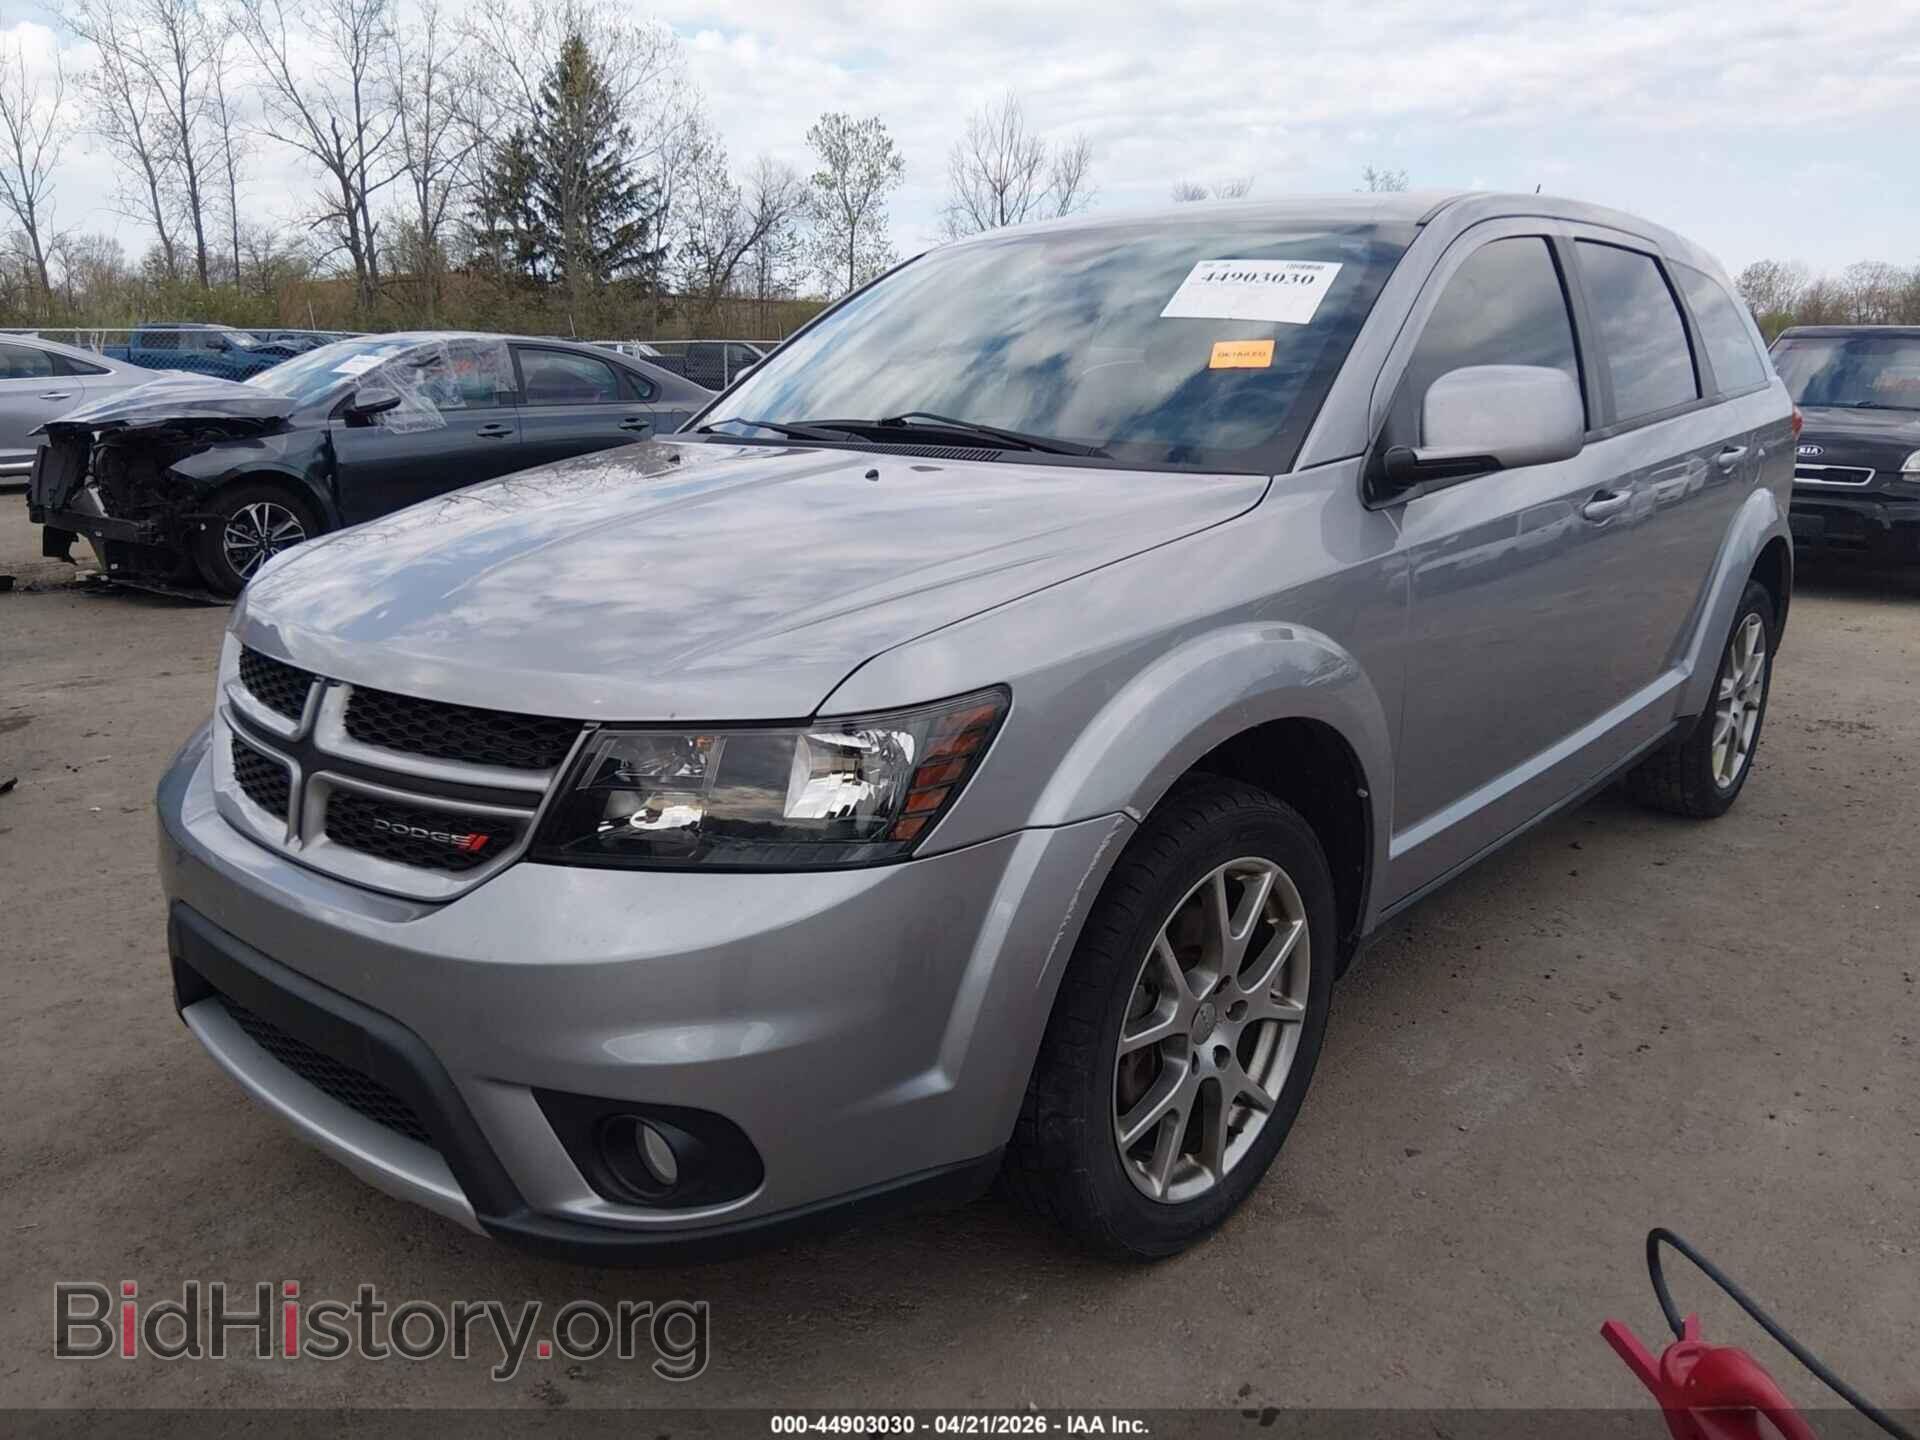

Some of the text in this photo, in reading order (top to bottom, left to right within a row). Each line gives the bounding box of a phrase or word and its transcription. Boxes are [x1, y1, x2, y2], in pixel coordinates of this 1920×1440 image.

[1202, 271, 1316, 286] 44903030
[1798, 446, 1819, 455] KIA
[373, 818, 473, 847] DODGE
